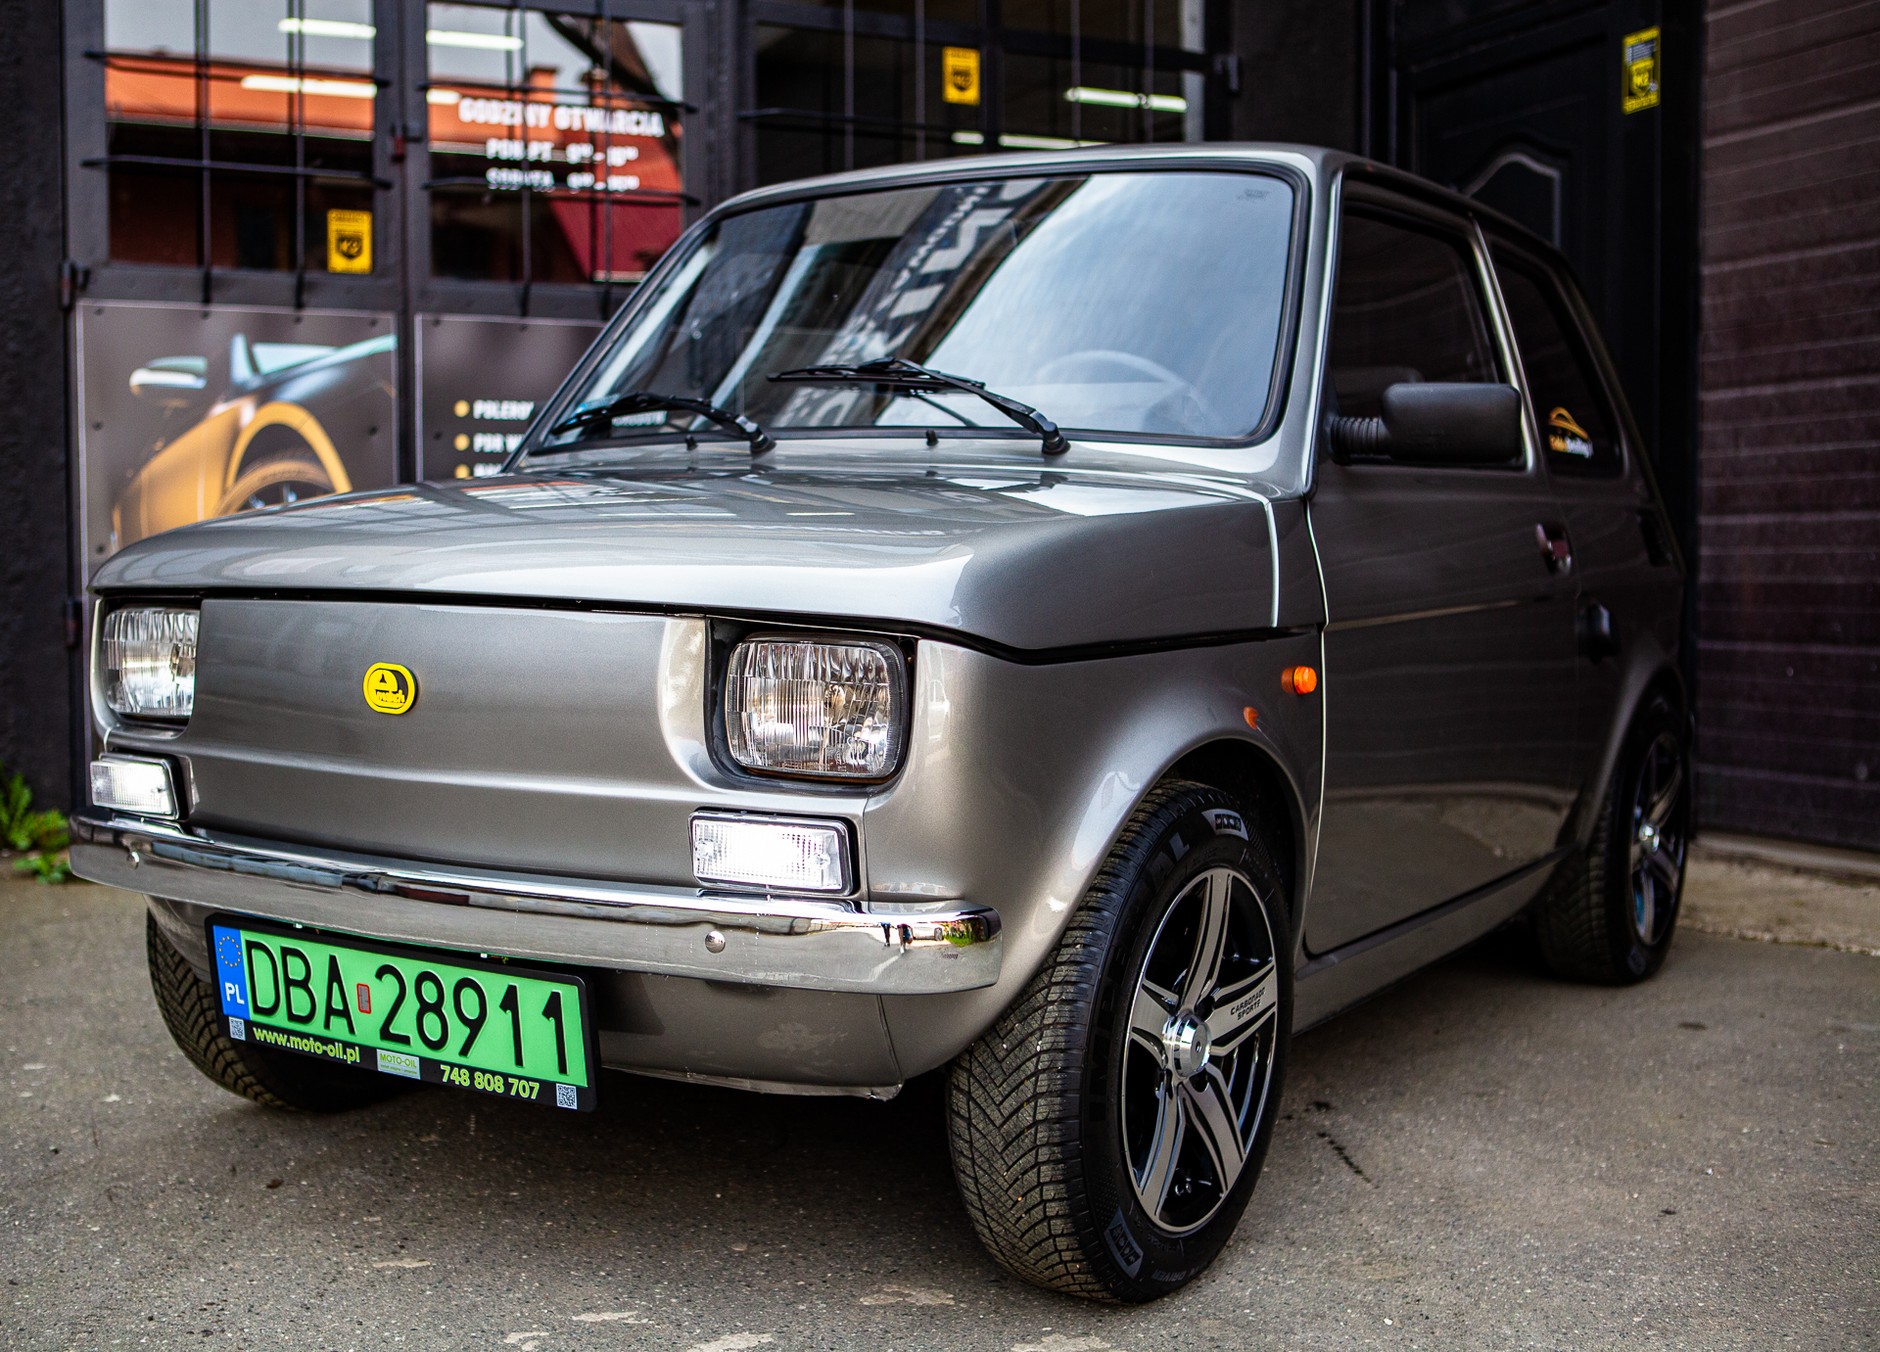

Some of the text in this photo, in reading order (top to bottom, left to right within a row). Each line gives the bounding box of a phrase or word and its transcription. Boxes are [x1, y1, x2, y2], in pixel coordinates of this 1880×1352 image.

[225, 982, 245, 1005] PL
[245, 939, 568, 1075] DBA 28911
[252, 1027, 360, 1064] www.moto-oil.pl
[380, 1053, 417, 1069] MOTO-OIL
[440, 1064, 471, 1087] 748
[474, 1071, 504, 1094] 808
[508, 1078, 540, 1100] 707
